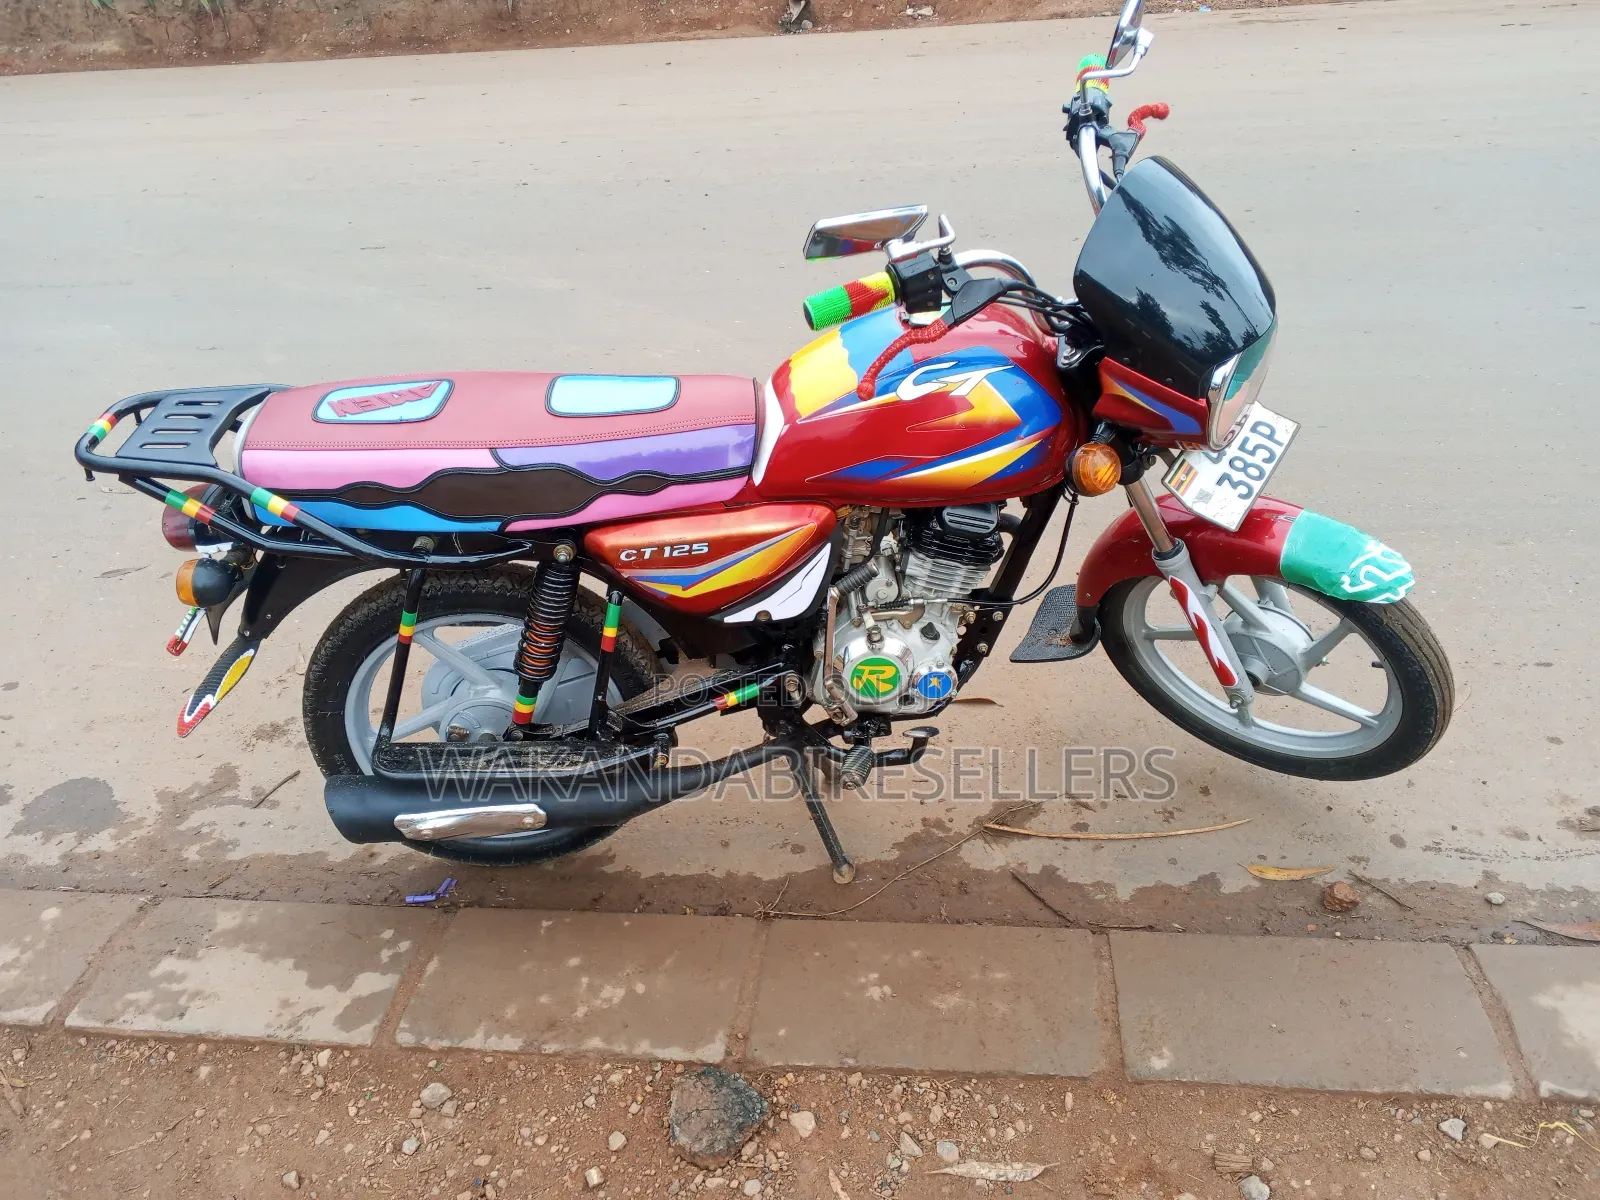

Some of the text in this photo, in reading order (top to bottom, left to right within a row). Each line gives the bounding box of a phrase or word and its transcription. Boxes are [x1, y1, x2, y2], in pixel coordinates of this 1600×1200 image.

[1216, 420, 1285, 500] 385P
[619, 542, 709, 562] CT 125
